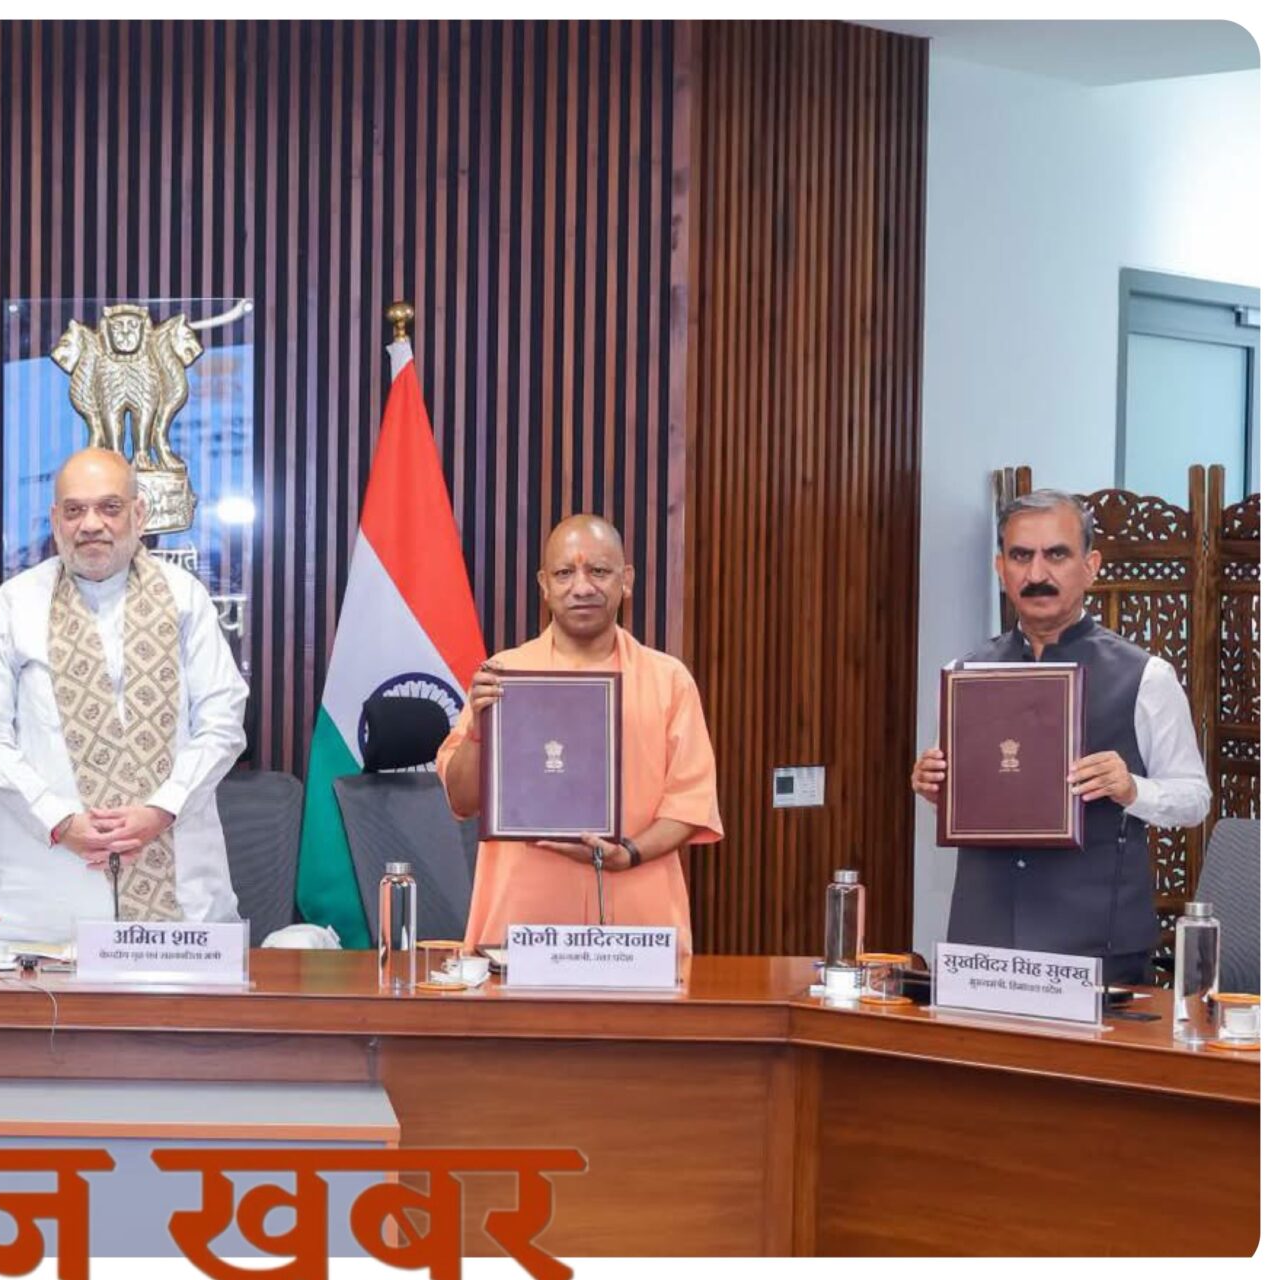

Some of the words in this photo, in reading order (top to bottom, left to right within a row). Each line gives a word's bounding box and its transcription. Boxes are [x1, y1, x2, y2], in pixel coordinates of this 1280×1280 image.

[113, 924, 167, 946] अमित
[171, 929, 210, 947] शाह
[512, 926, 559, 947] योगी
[563, 926, 672, 949] आदित्यनाथ
[943, 952, 1008, 974] सुखविंदर
[1012, 956, 1043, 977] सिंह
